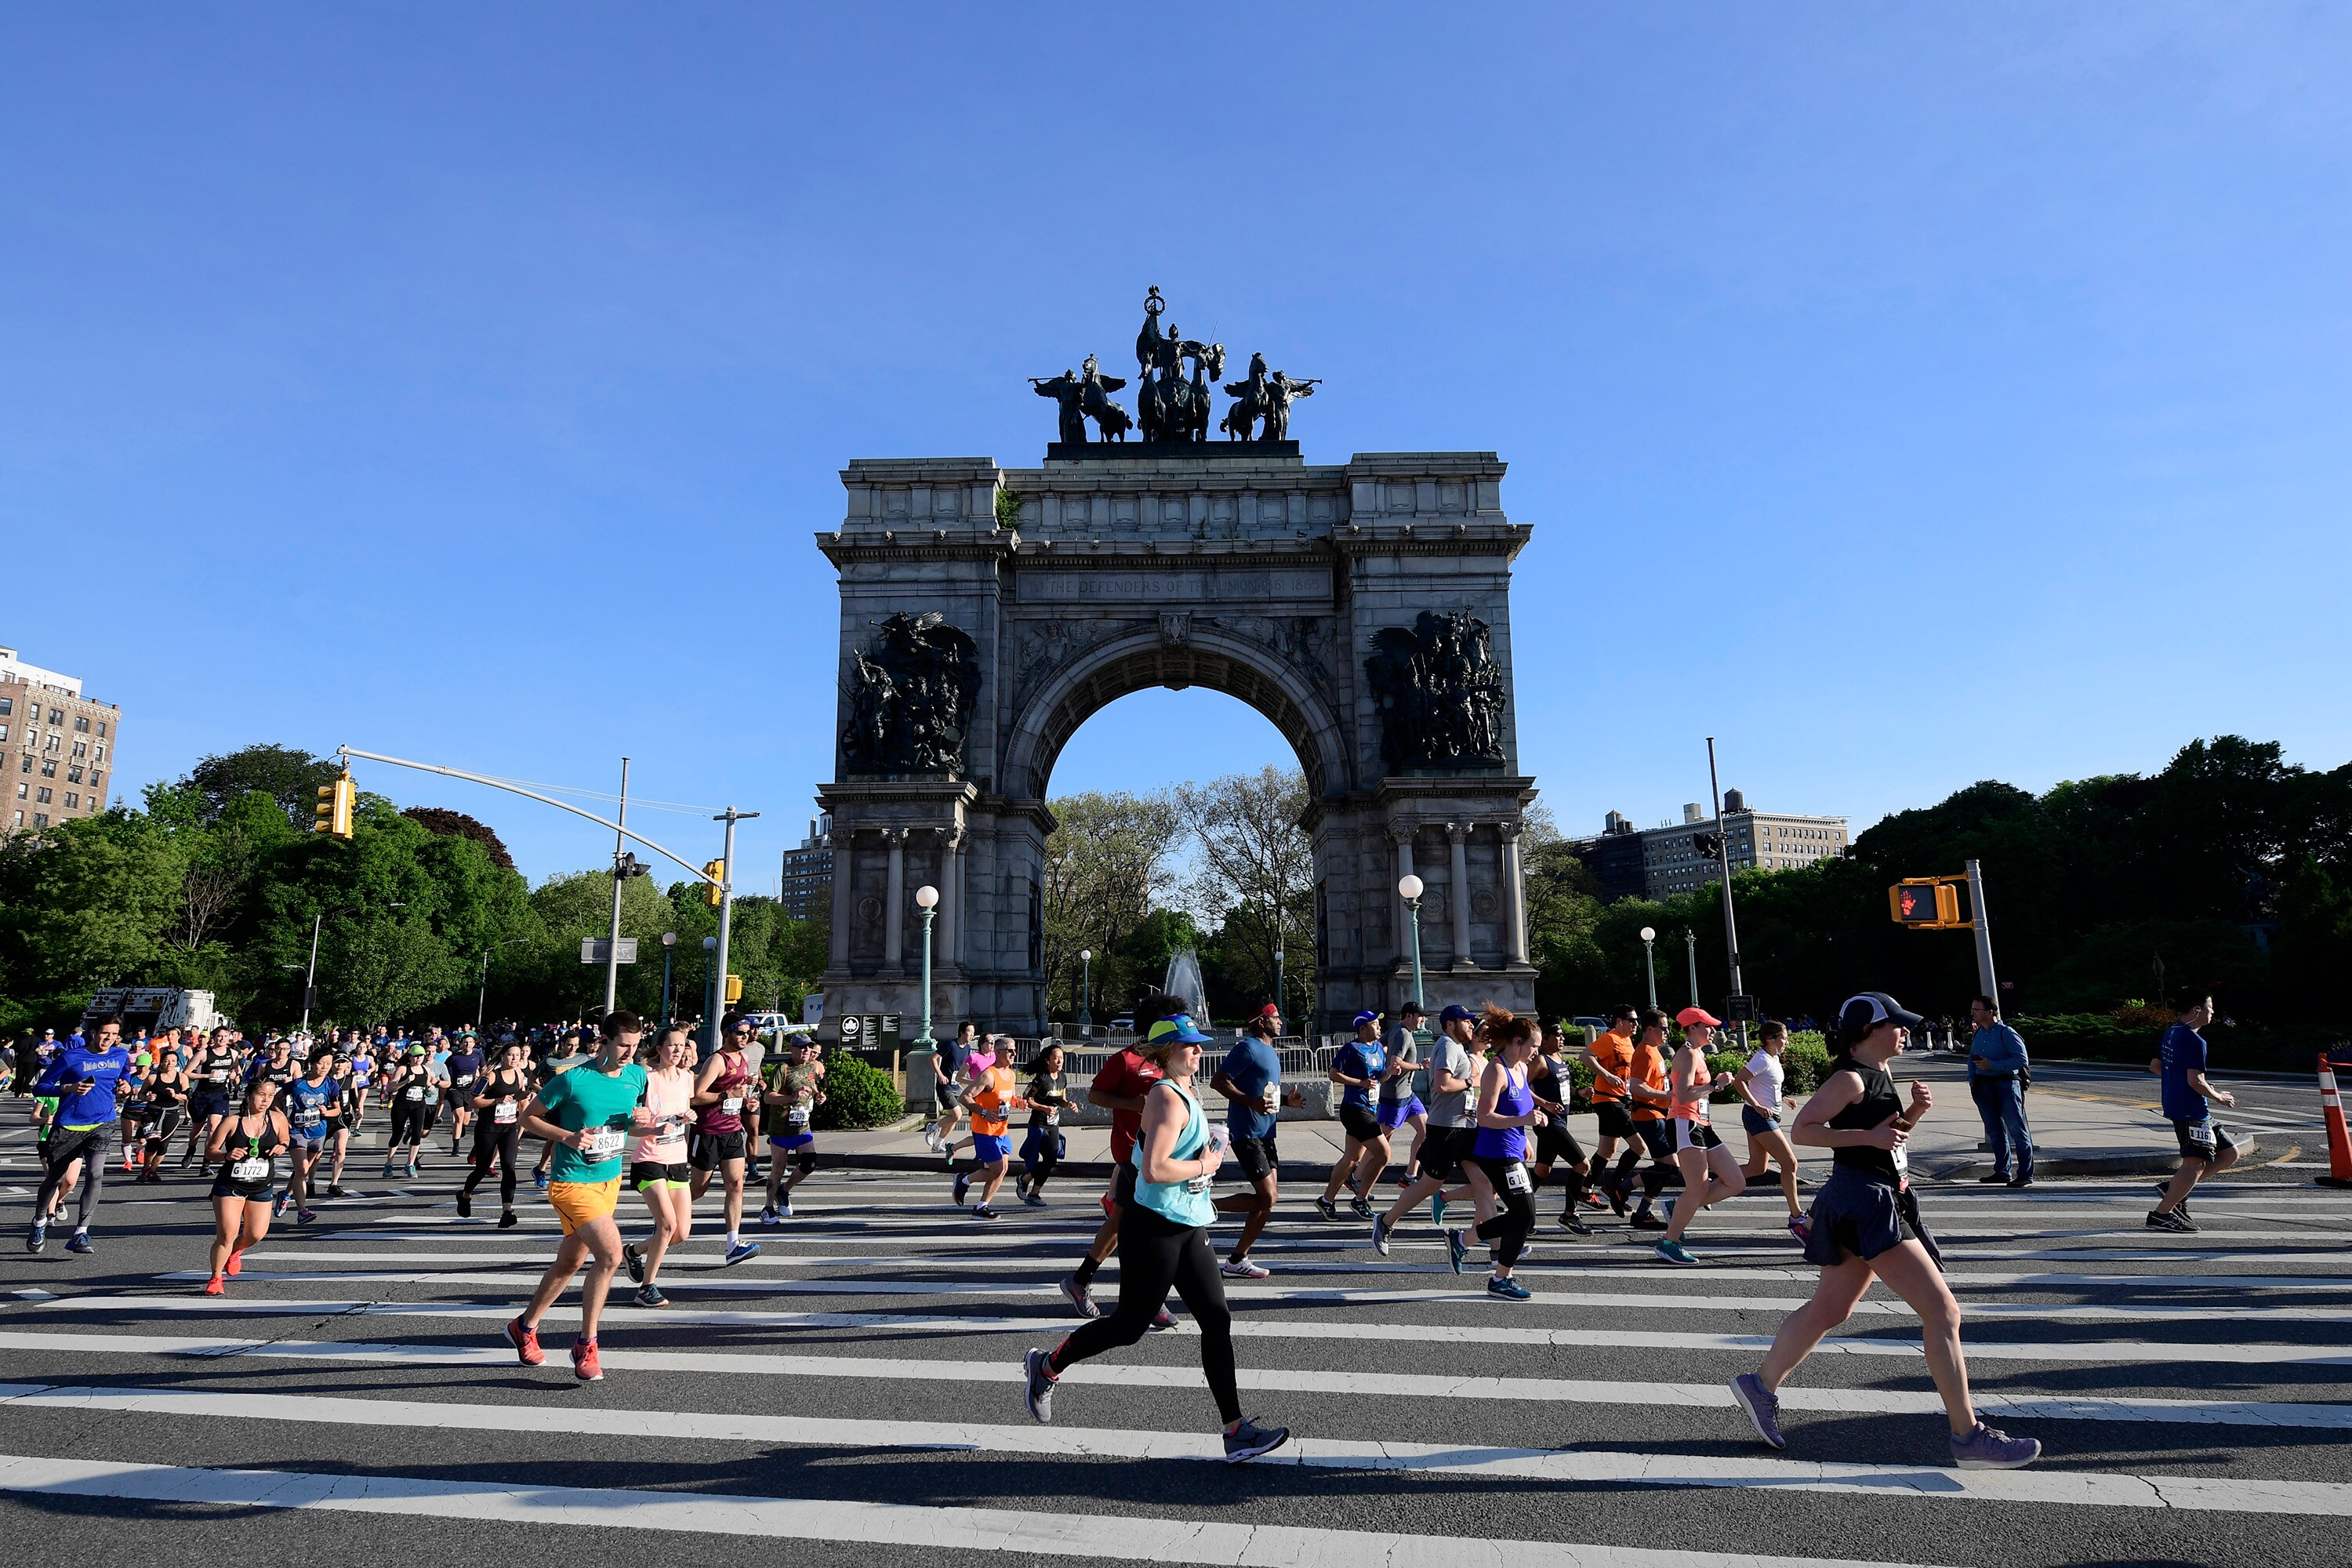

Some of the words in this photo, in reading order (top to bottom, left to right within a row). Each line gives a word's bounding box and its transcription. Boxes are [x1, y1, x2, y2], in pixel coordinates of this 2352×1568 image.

[1050, 581, 1076, 593] THE
[1080, 581, 1160, 593] DEFENDERS
[1167, 581, 1184, 593] OF
[1188, 580, 1214, 593] THE
[1218, 580, 1258, 592] UNION
[1261, 579, 1285, 591] 1861
[1292, 579, 1320, 591] 1865
[598, 1134, 619, 1149] 8622
[243, 1167, 262, 1175] 1772
[1509, 1176, 1515, 1185] G
